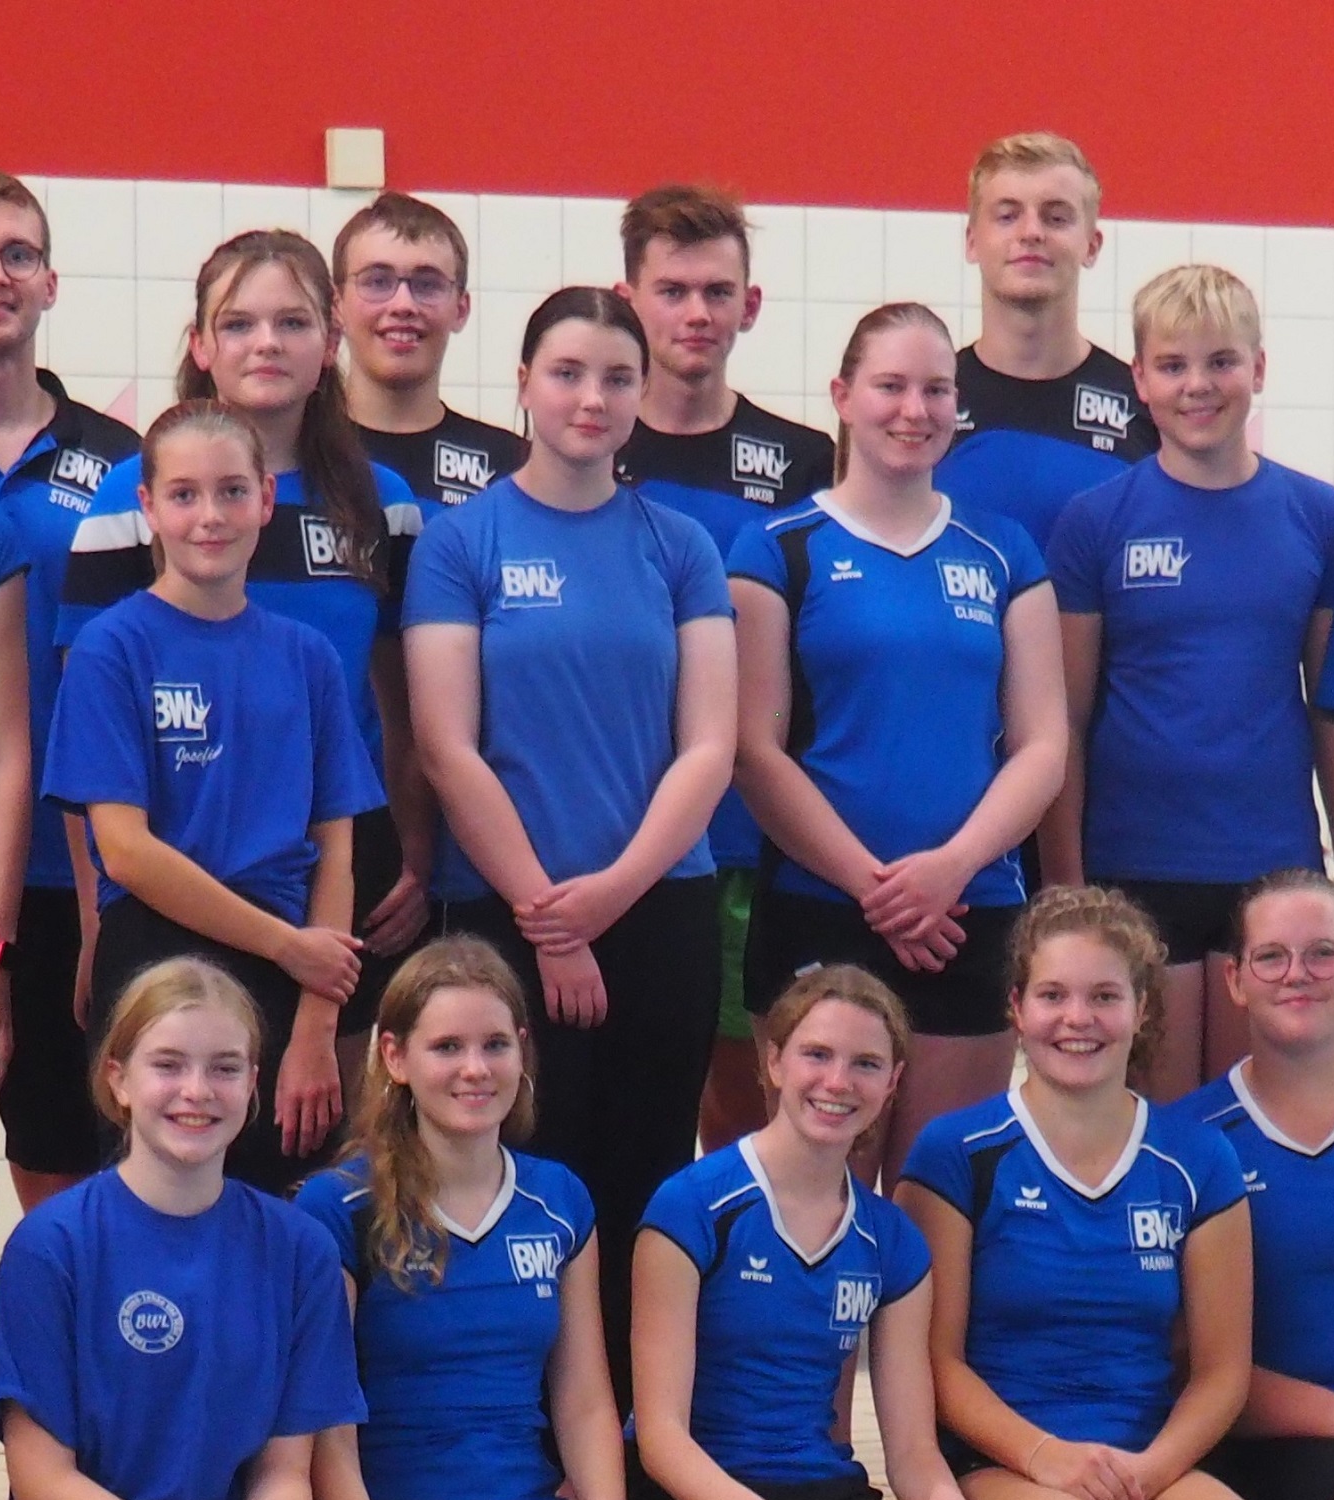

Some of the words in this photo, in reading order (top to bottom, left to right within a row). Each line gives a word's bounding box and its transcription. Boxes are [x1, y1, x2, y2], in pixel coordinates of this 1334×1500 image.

[1079, 391, 1127, 430] BWL
[736, 442, 782, 480] BWL
[1092, 435, 1114, 451] BEN
[439, 447, 487, 488] BWL
[1128, 545, 1183, 577] BWL
[501, 565, 560, 598] BWL
[943, 564, 997, 605] BWL
[154, 690, 205, 730] BWL
[511, 1241, 558, 1279] BWL
[136, 1313, 170, 1329] BWL
